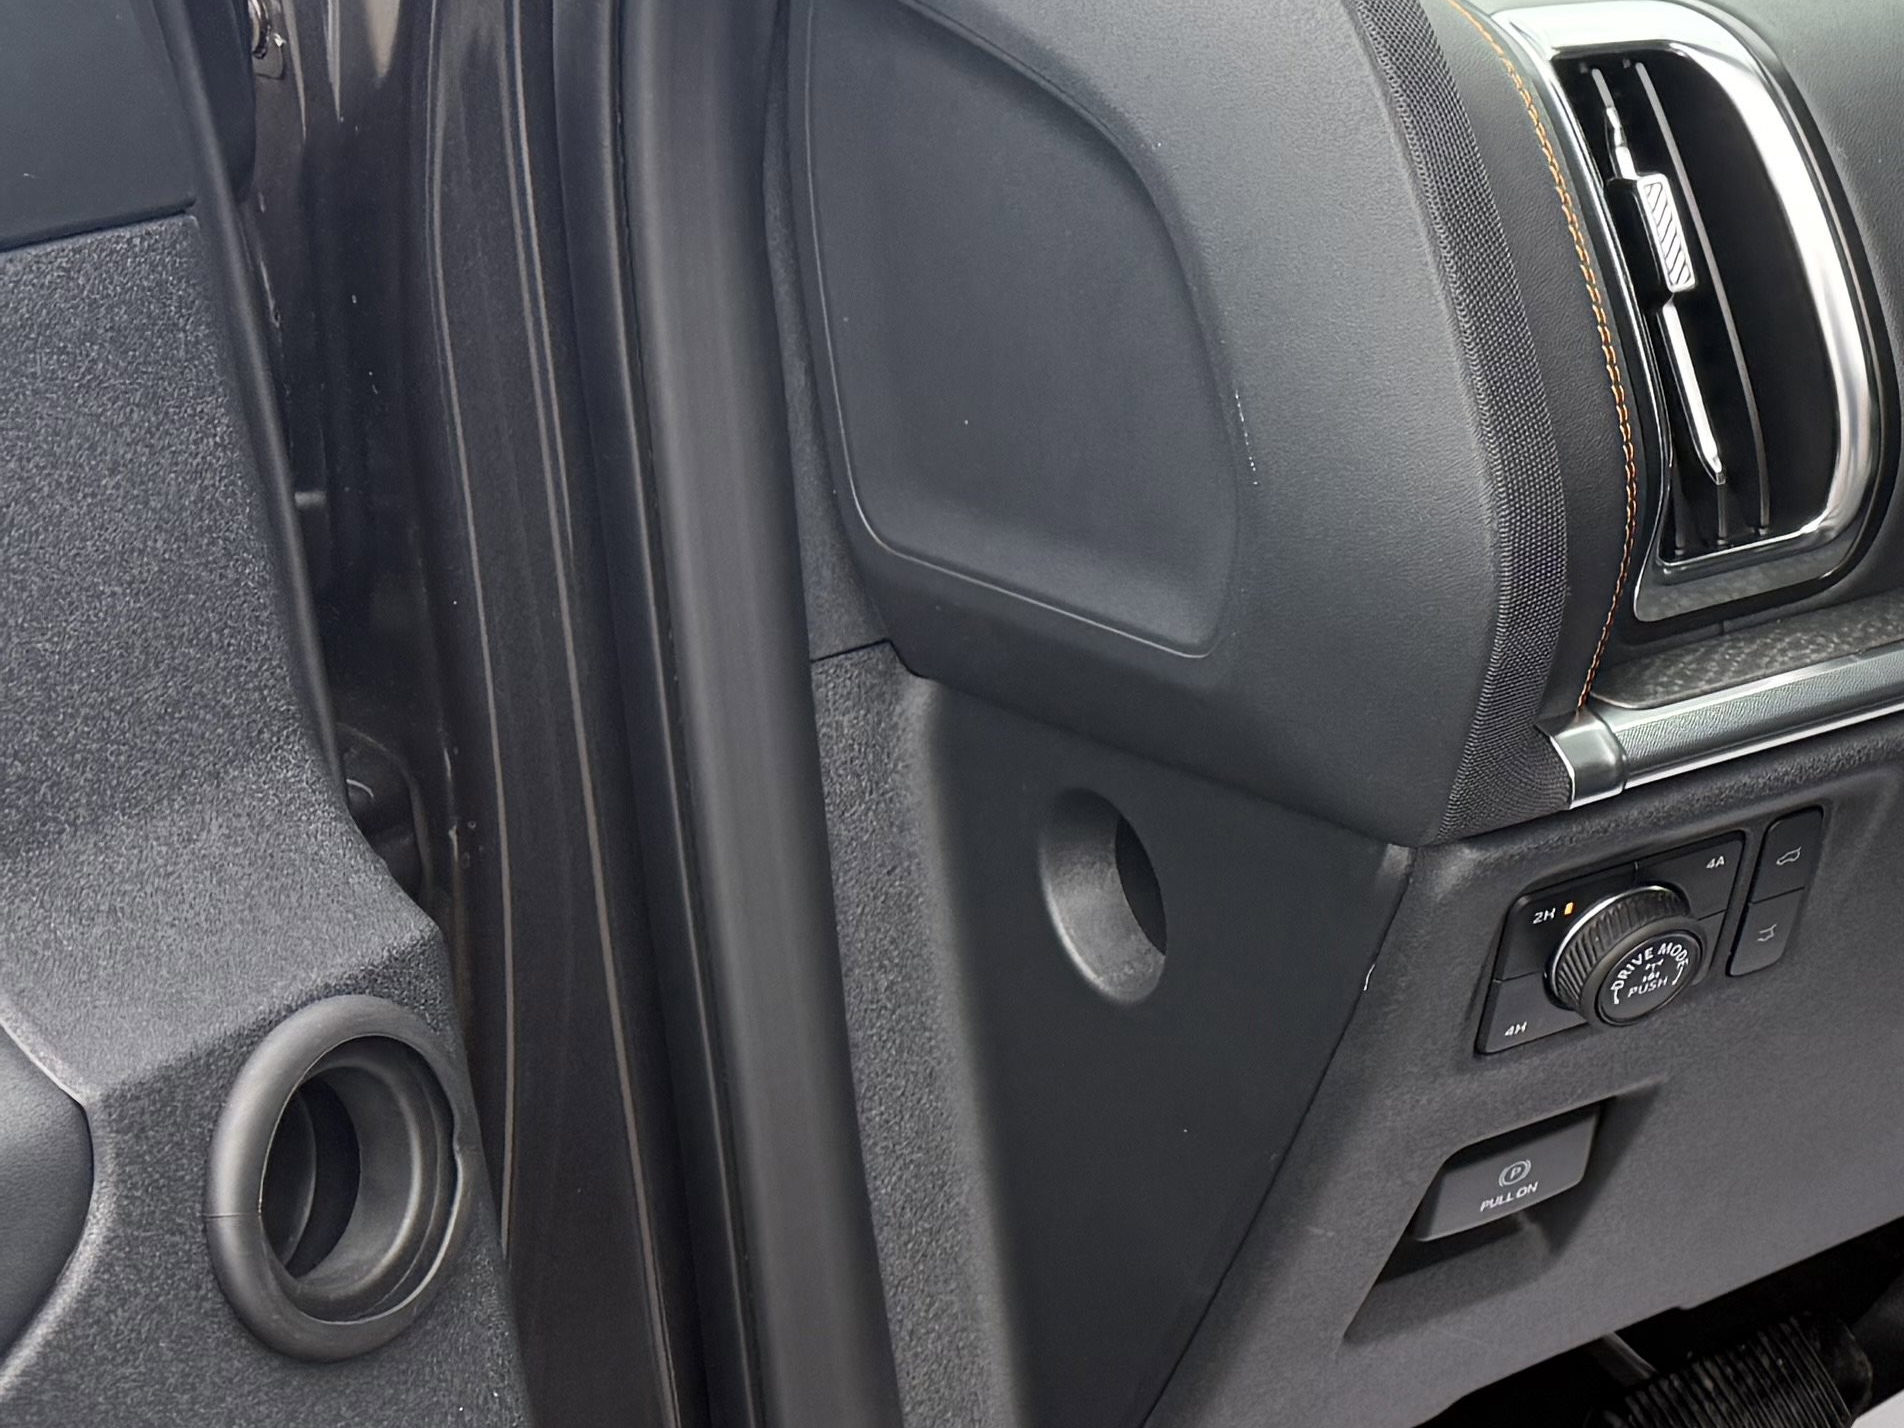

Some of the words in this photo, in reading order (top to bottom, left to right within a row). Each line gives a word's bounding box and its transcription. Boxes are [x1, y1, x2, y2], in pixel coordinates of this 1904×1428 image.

[1706, 855, 1725, 870] 4A
[1532, 907, 1556, 924] 2H
[1610, 946, 1654, 991] DRIVE
[1657, 941, 1689, 969] MODE
[1627, 976, 1668, 998] PUSH
[1504, 1021, 1528, 1037] 4H
[1480, 1191, 1515, 1213] PULL
[1516, 1181, 1539, 1199] ON
